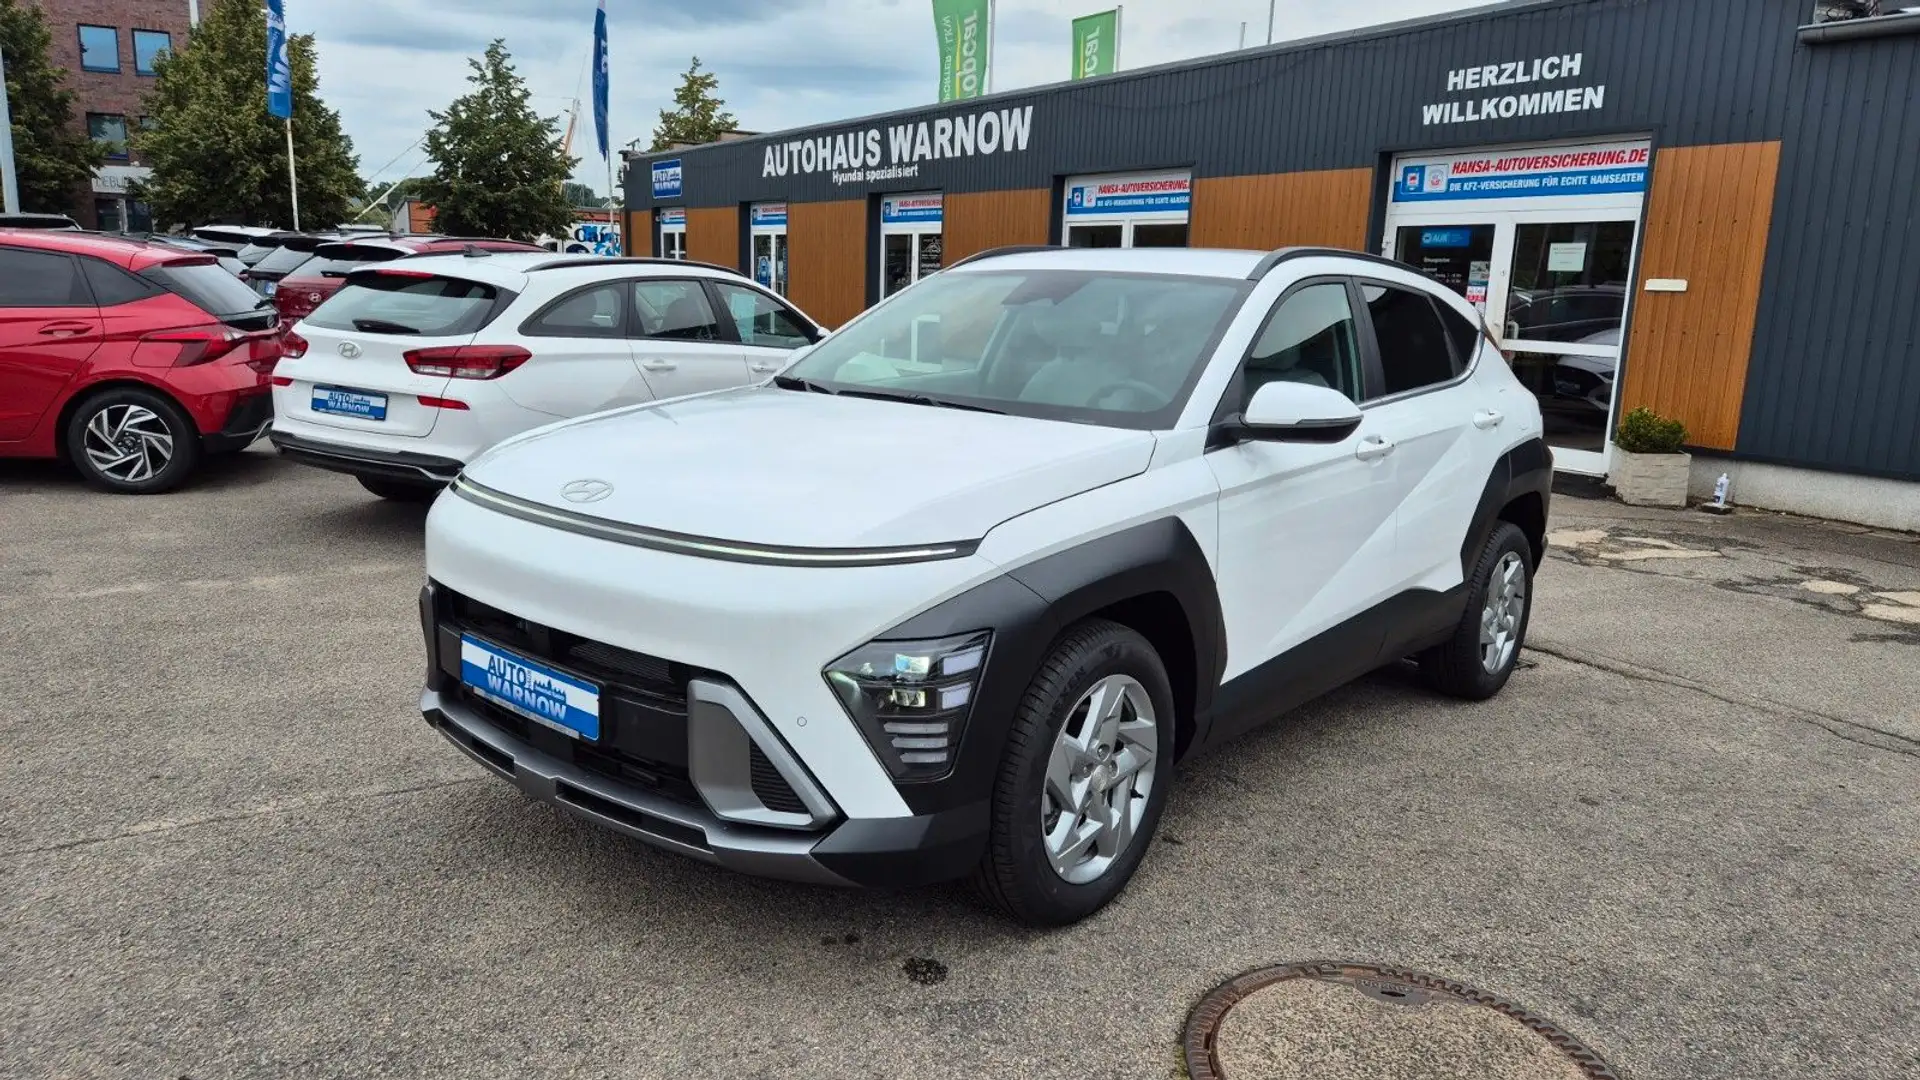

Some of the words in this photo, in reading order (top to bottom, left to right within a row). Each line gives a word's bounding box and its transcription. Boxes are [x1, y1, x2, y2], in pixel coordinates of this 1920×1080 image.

[1446, 53, 1583, 91] HERZLICH
[1423, 85, 1605, 125] WILLKOMMEN
[762, 129, 881, 178] AUTOHAUS
[888, 105, 1033, 164] WARNOW
[832, 170, 864, 186] Hyundai
[865, 164, 919, 182] spezialisiert
[1452, 147, 1648, 174] HANSA-AUTOVERSICHERUNG.DE
[1449, 181, 1462, 191] DIE
[1463, 178, 1540, 190] KFZ-VERSICHERUNG
[1542, 175, 1558, 187] FÜR
[1560, 175, 1587, 186] ECHTE
[1590, 172, 1644, 185] HANSEATEN
[328, 392, 351, 404] AUTO
[328, 400, 370, 413] WARNOW
[488, 655, 527, 687] AUTO
[487, 674, 566, 720] WARNOW
